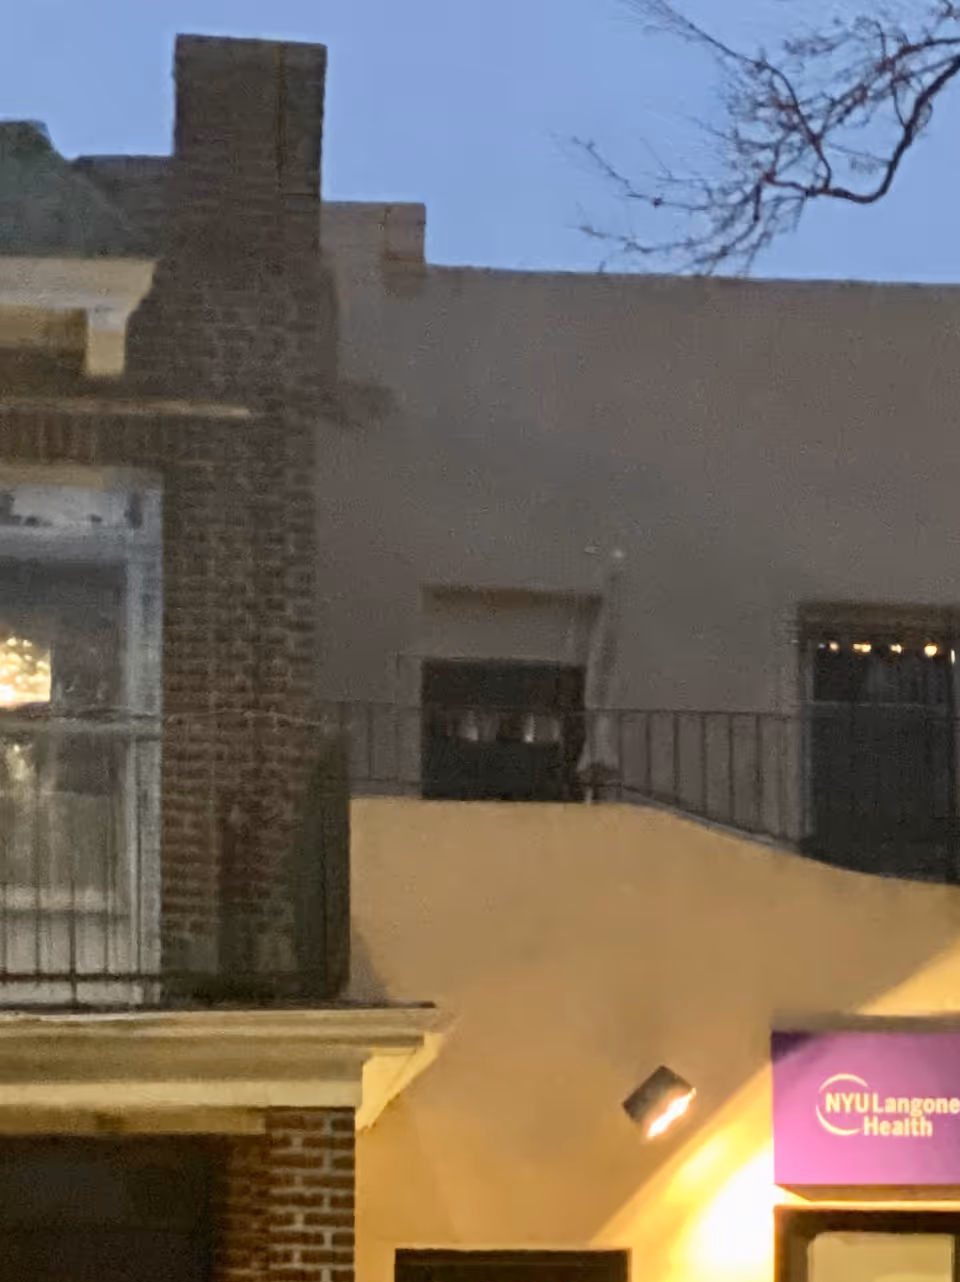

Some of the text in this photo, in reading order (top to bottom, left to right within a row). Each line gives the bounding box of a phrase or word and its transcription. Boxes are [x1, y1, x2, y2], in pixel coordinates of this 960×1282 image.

[825, 1092, 960, 1118] NYU Langone
[863, 1115, 933, 1137] Health
